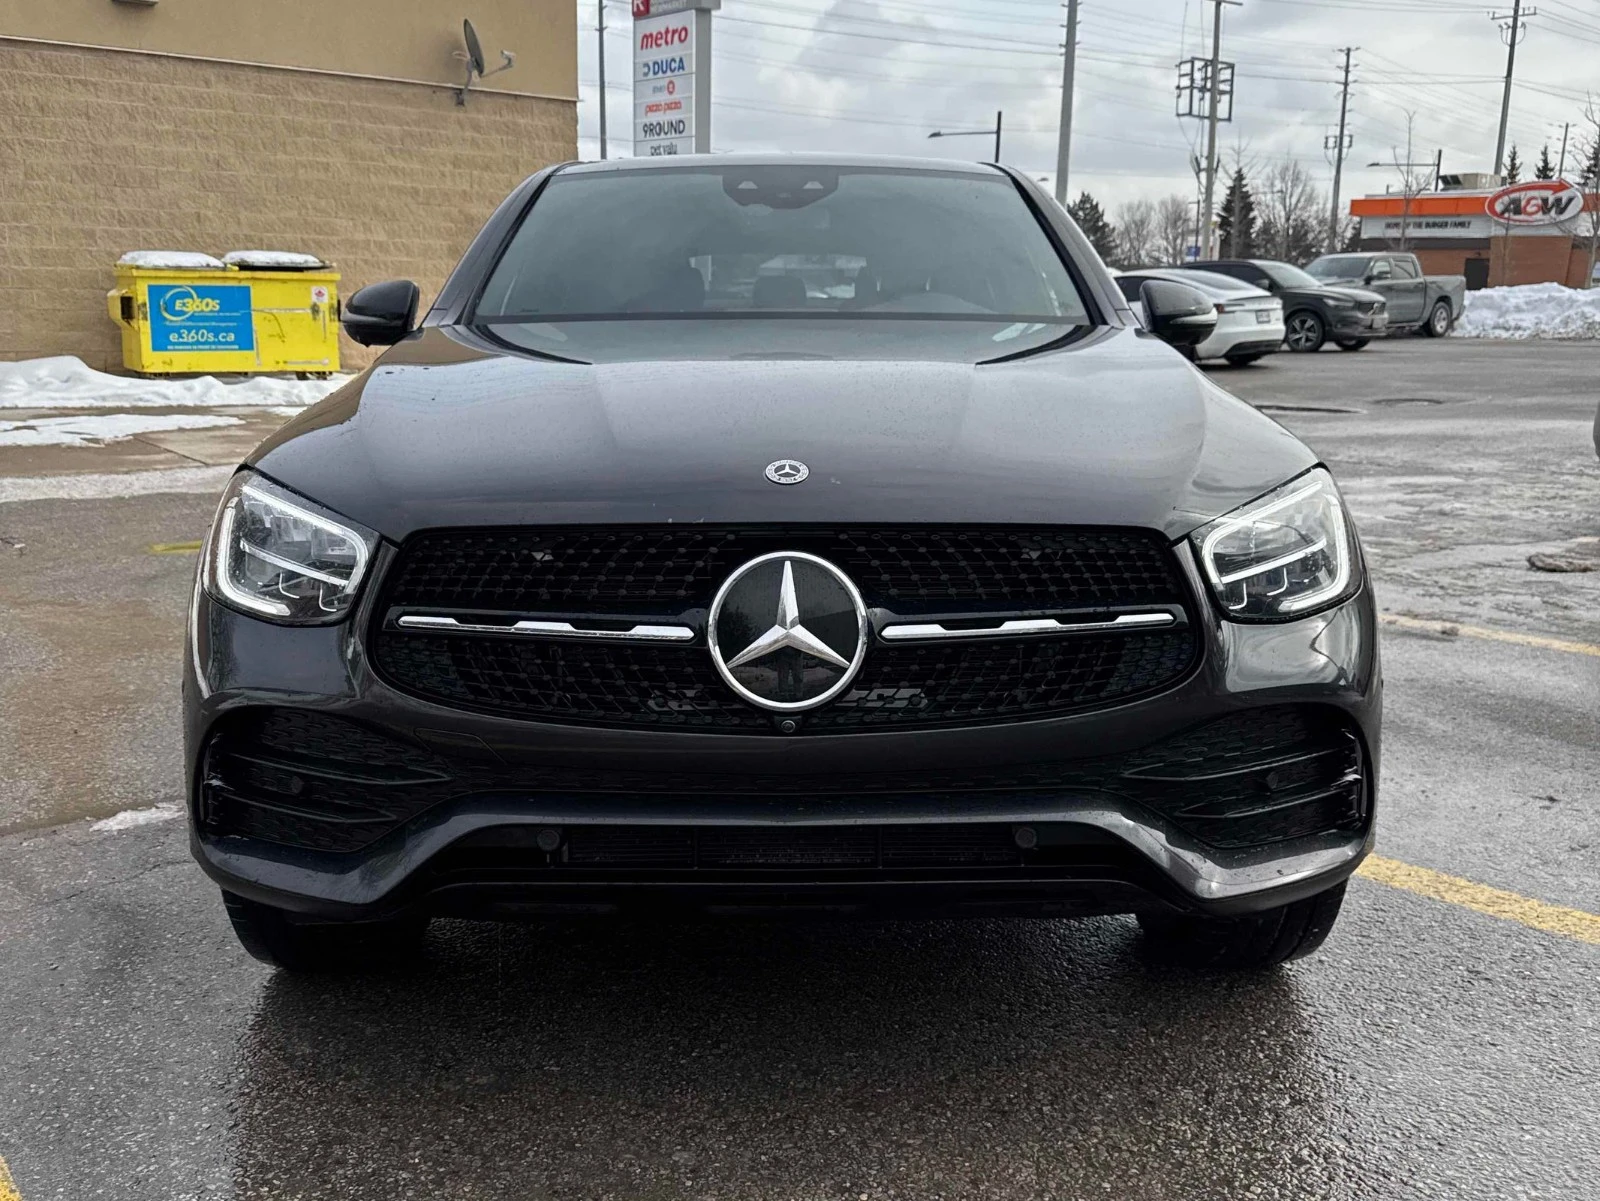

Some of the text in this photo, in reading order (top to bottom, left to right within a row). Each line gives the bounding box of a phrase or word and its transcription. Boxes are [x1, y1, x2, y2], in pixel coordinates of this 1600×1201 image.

[640, 25, 689, 51] metro
[652, 57, 685, 75] DUCA
[643, 120, 685, 138] 9ROUND
[1500, 196, 1576, 216] A&W
[169, 329, 235, 342] e360s.ca
